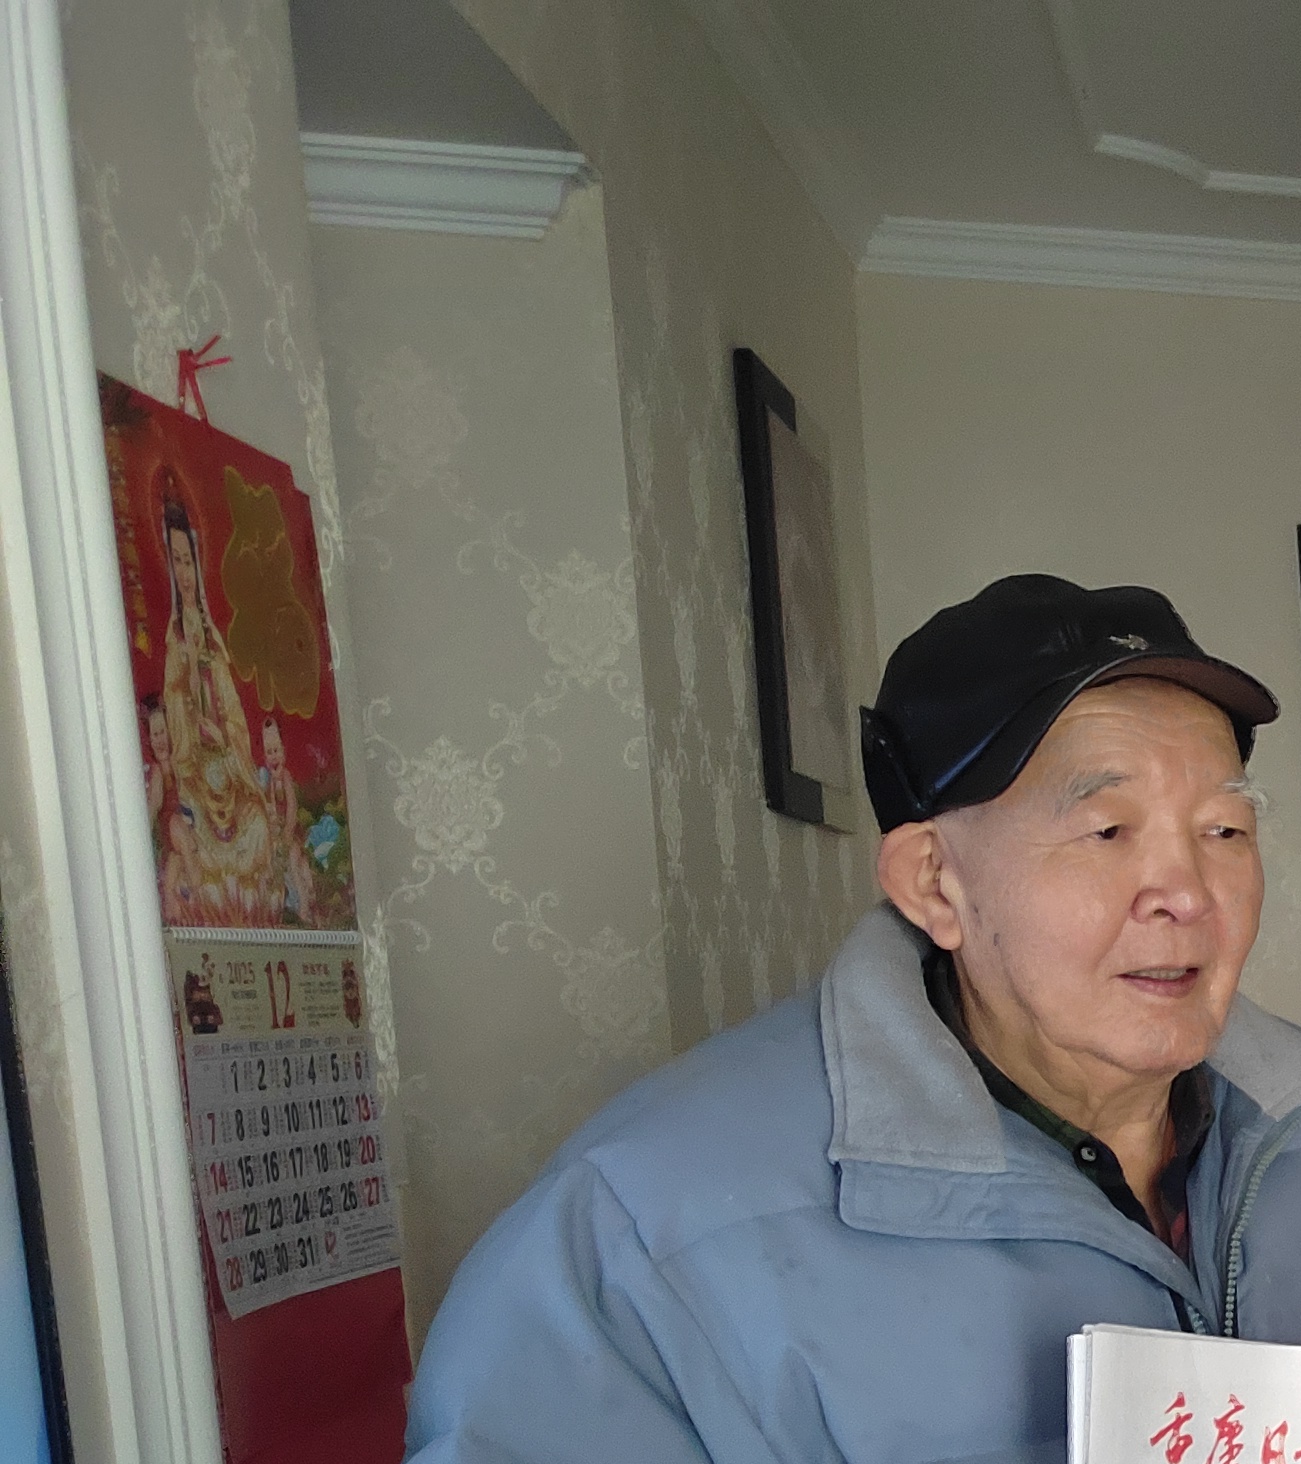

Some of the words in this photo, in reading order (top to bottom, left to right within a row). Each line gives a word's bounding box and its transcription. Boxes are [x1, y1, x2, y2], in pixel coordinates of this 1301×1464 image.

[264, 961, 296, 1029] 12
[230, 1060, 239, 1093] 1
[257, 1059, 267, 1090] 2
[282, 1057, 291, 1088] 3
[308, 1055, 316, 1085] 4
[330, 1053, 339, 1082] 5
[354, 1051, 362, 1080] 6
[207, 1112, 215, 1145] 7
[235, 1109, 245, 1141] 8
[261, 1106, 270, 1137] 9
[284, 1102, 299, 1133] 10
[308, 1099, 322, 1129] 11
[332, 1096, 348, 1126] 12
[355, 1093, 371, 1122] 13
[210, 1161, 228, 1195] 14
[237, 1155, 254, 1189] 15
[263, 1151, 280, 1183] 16
[289, 1147, 303, 1178] 17
[313, 1143, 329, 1173] 18
[337, 1139, 351, 1168] 19
[358, 1135, 376, 1165] 20
[217, 1208, 234, 1244] 21
[242, 1202, 261, 1236] 22
[268, 1197, 284, 1230] 23
[293, 1191, 309, 1224] 24
[318, 1185, 333, 1218] 25
[340, 1181, 357, 1211] 26
[364, 1177, 380, 1207] 27
[226, 1257, 243, 1292] 28
[250, 1249, 267, 1284] 29
[274, 1242, 289, 1275] 30
[297, 1236, 314, 1268] 31
